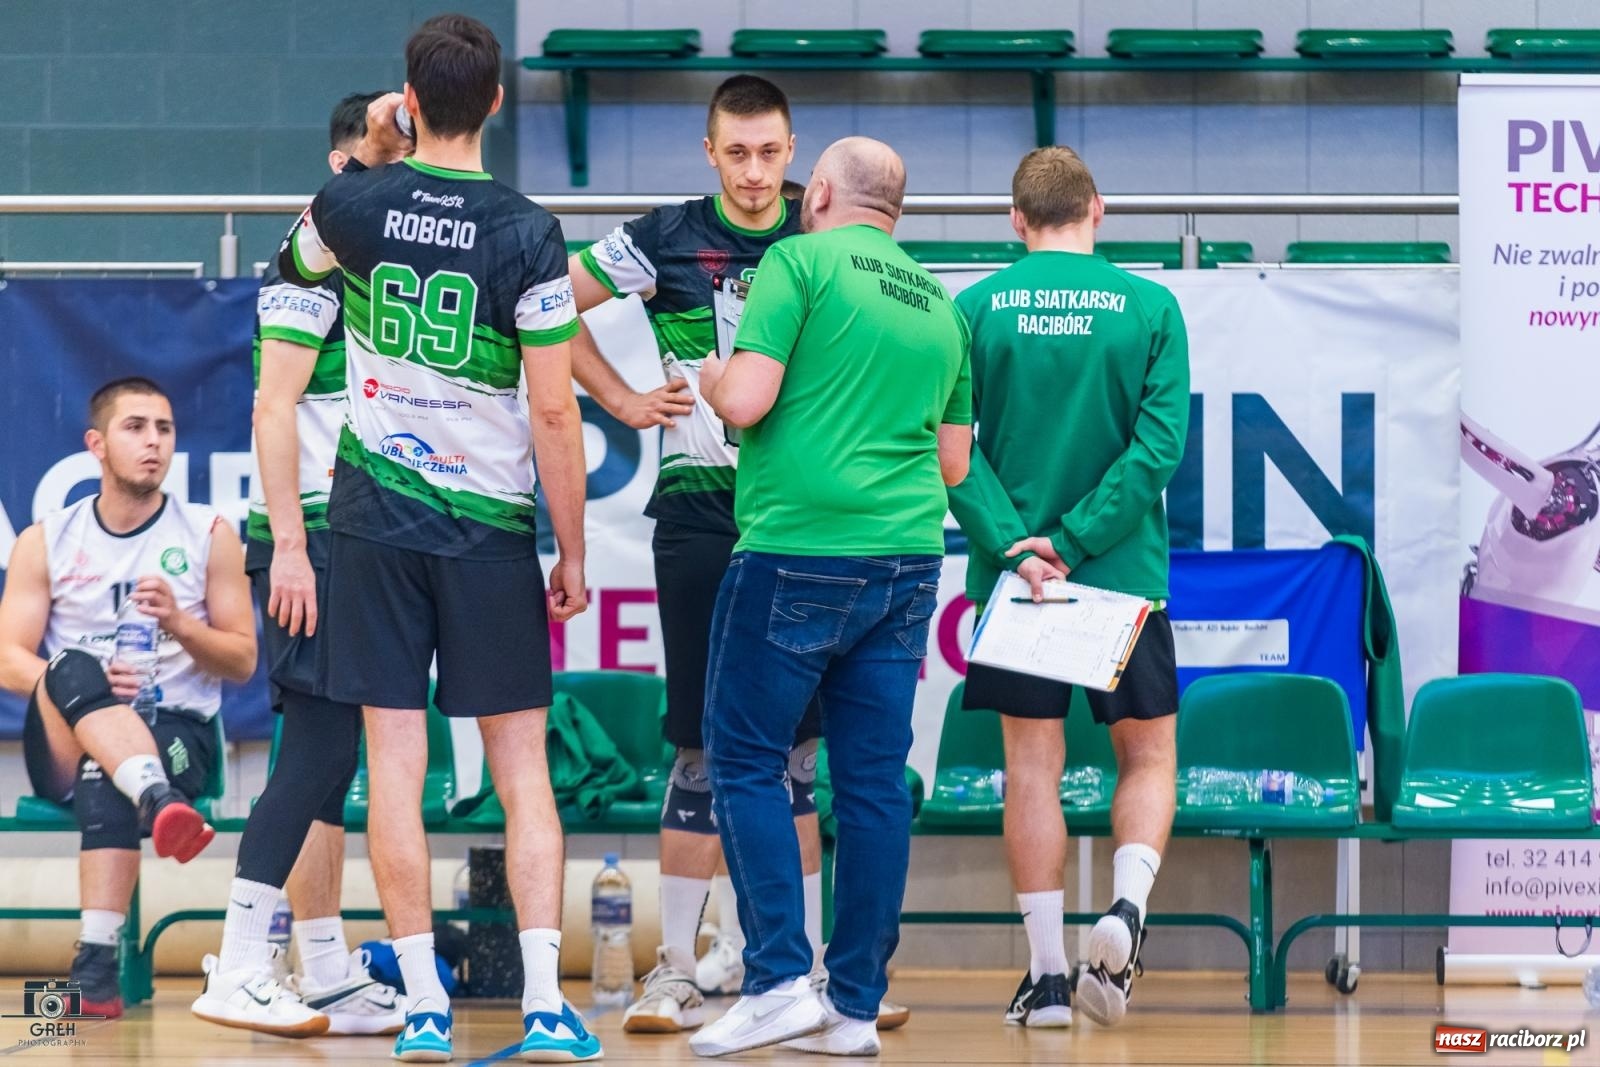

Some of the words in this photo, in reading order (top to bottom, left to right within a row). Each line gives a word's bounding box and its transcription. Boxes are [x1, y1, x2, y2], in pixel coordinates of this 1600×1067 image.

[1508, 120, 1600, 172] PIV
[1508, 183, 1600, 212] TECH
[383, 209, 477, 250] ROBCIO
[1493, 244, 1533, 265] Nie
[850, 254, 884, 274] KLUB
[885, 262, 944, 301] SIATKARSKI
[1559, 275, 1566, 297] i
[1570, 281, 1600, 302] po
[879, 279, 931, 313] RACIBÓRZ
[991, 289, 1031, 311] KLUB
[1034, 289, 1127, 313] SIATKARSKI
[370, 261, 479, 369] 69
[1017, 312, 1094, 335] RACIBÓRZ
[380, 390, 472, 410] VANESSA
[429, 454, 465, 464] MULTI
[1260, 653, 1286, 663] TEAM
[1486, 848, 1515, 868] tel.
[1523, 849, 1547, 868] 32
[1554, 849, 1591, 868] 414
